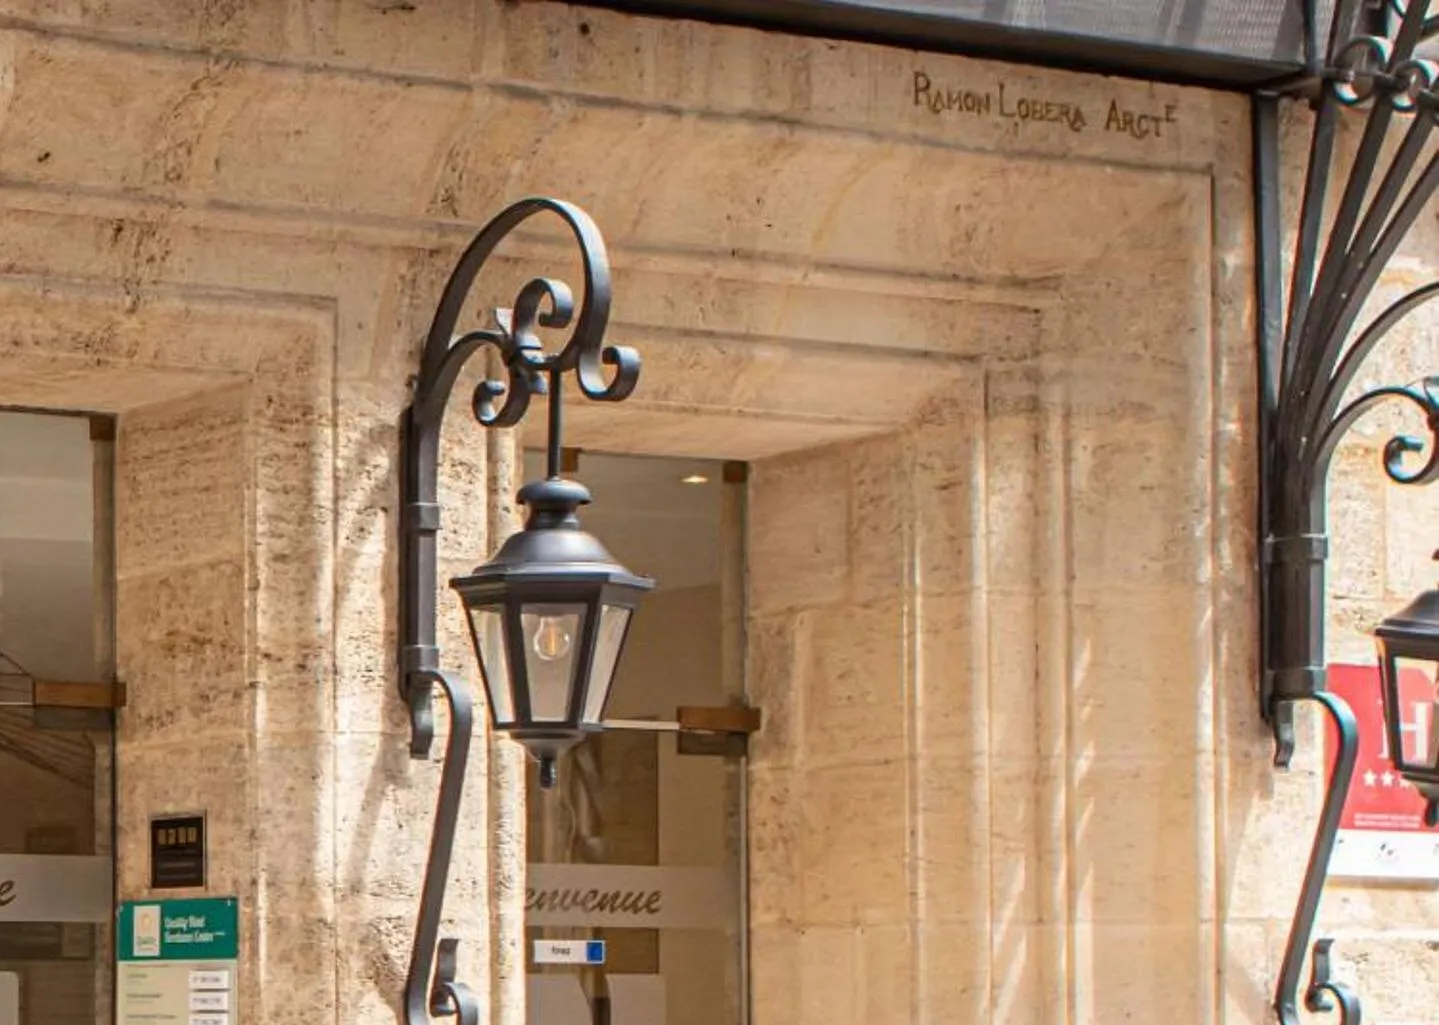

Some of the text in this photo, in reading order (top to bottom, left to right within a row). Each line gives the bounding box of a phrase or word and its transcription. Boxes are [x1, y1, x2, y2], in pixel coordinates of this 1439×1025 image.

[914, 71, 990, 114] RAMON
[998, 83, 1086, 132] LOBERA
[525, 888, 662, 914] envenue
